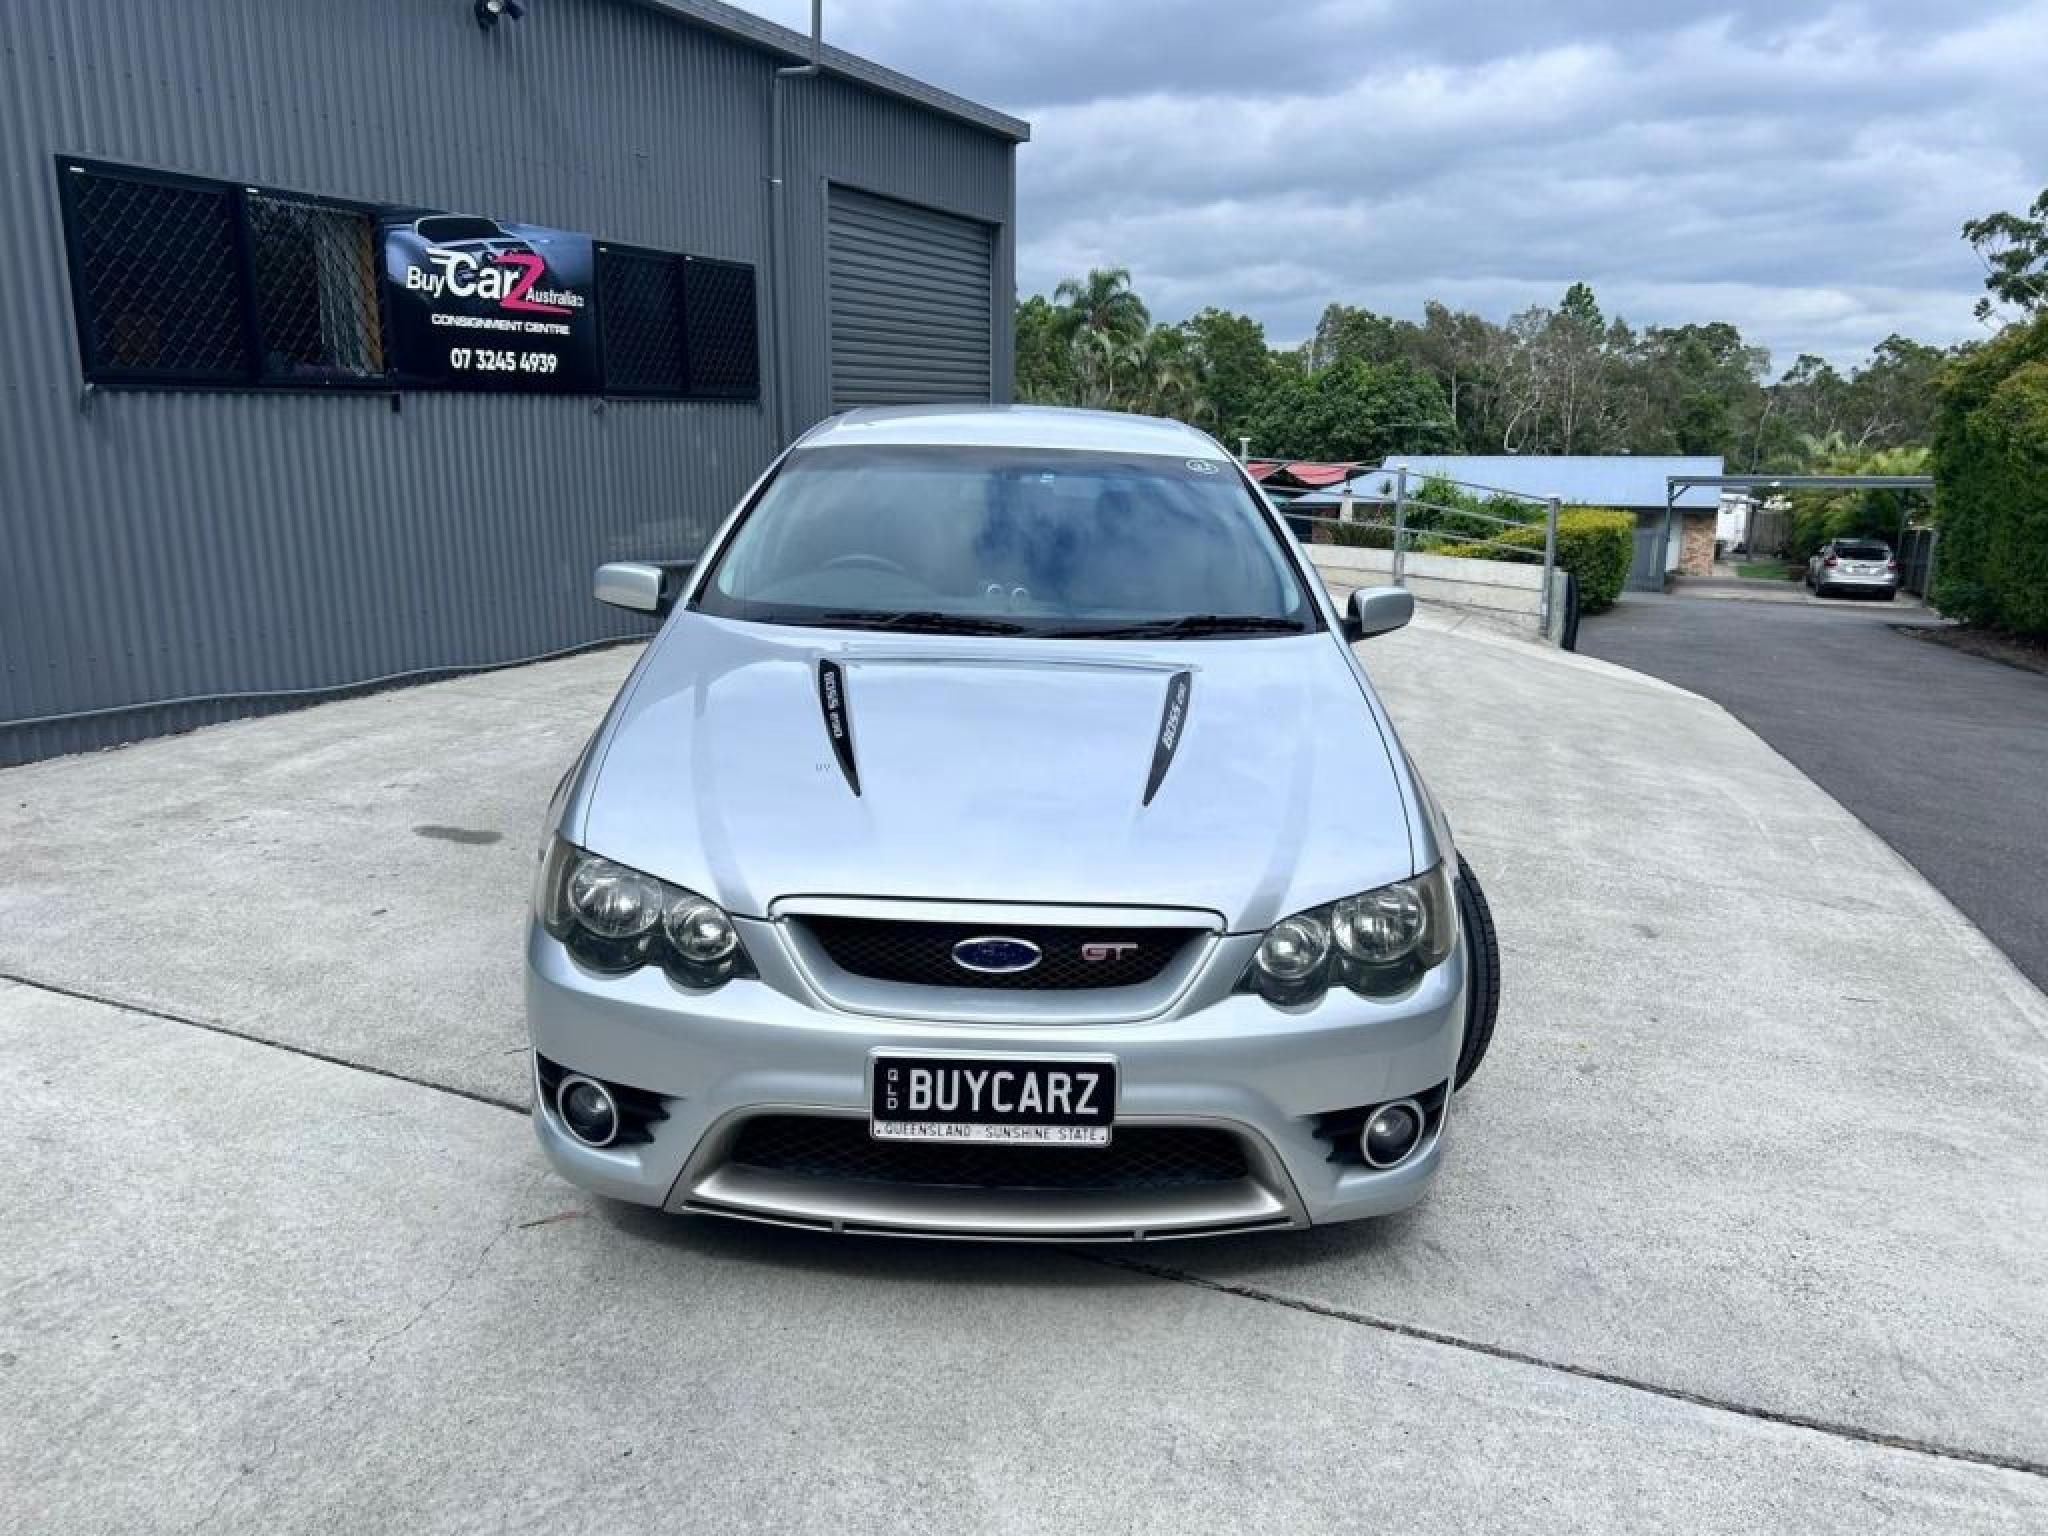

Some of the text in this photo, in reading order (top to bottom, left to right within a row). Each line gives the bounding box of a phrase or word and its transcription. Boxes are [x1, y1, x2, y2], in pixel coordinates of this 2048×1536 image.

[431, 313, 570, 335] CONSIGNMENT CENTRE
[451, 347, 558, 373] 07 3245 4939
[1082, 942, 1138, 960] GT
[908, 1068, 1100, 1115] BUYCARZ
[885, 1121, 1097, 1141] QUEENSLAND SUNSHINE STATE
